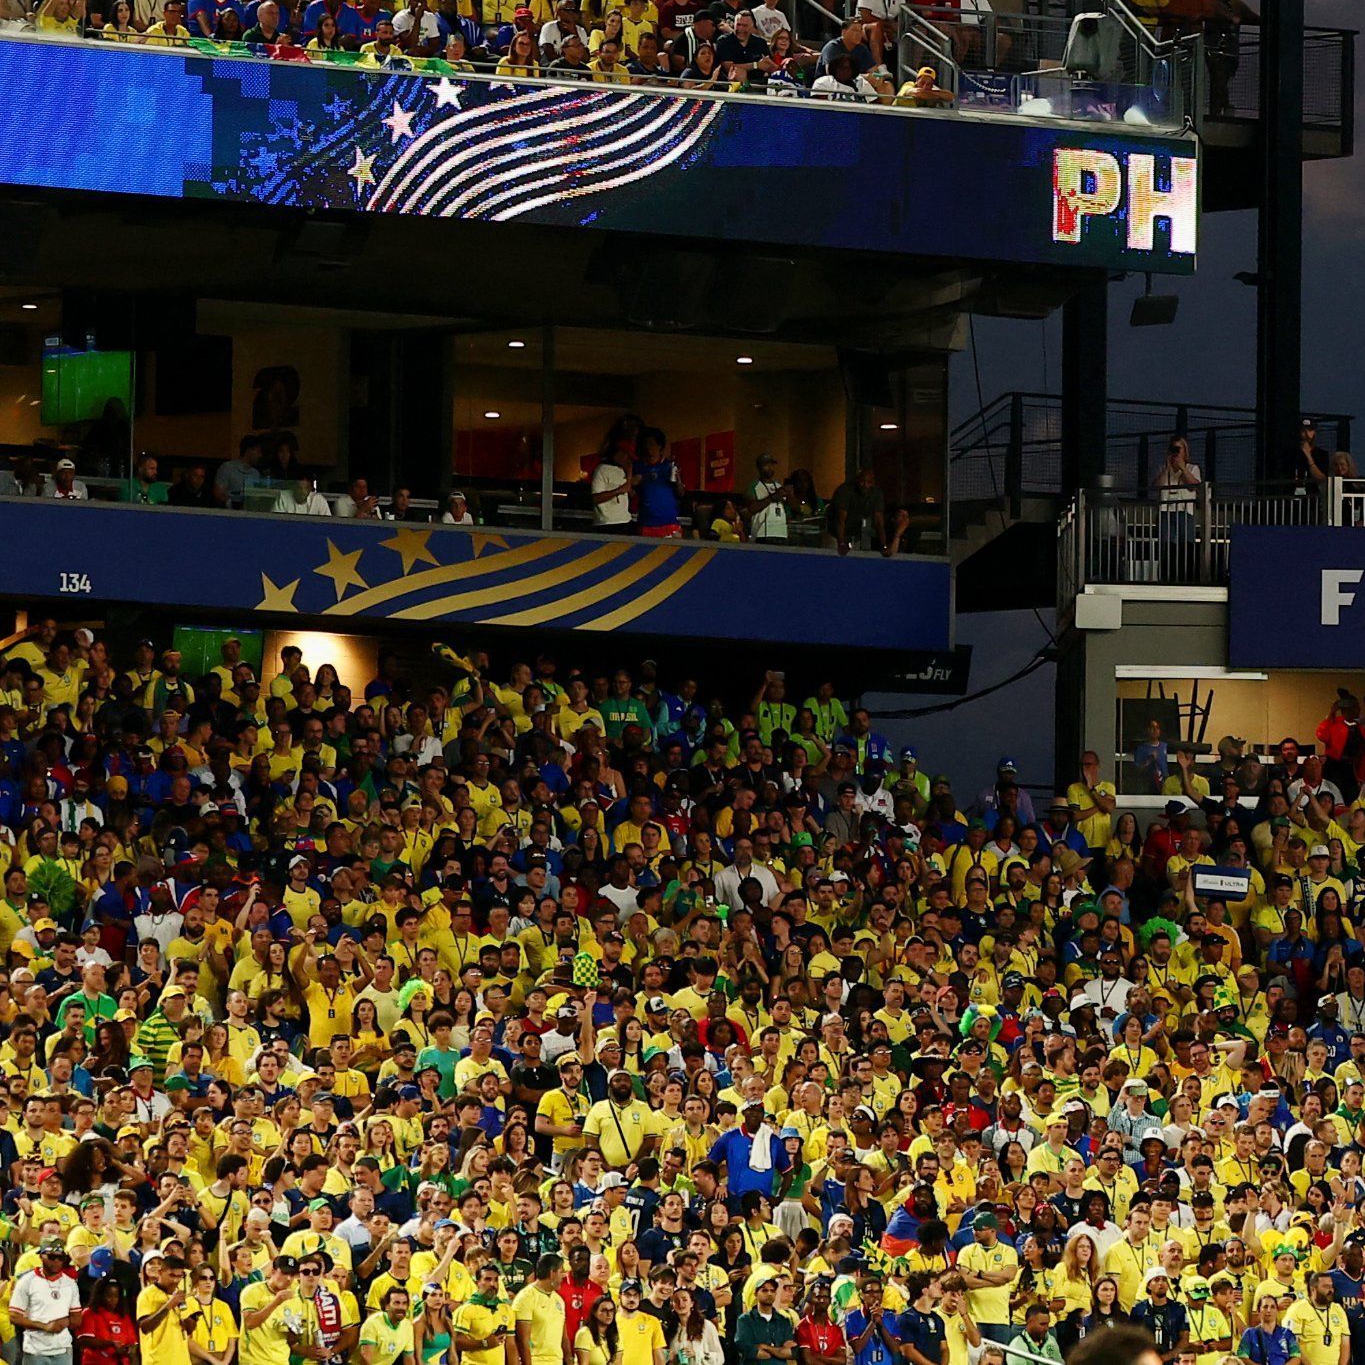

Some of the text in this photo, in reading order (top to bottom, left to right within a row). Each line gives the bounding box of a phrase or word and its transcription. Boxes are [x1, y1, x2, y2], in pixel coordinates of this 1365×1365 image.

[1053, 148, 1198, 254] PH
[59, 572, 92, 593] 134
[935, 669, 953, 681] FLY
